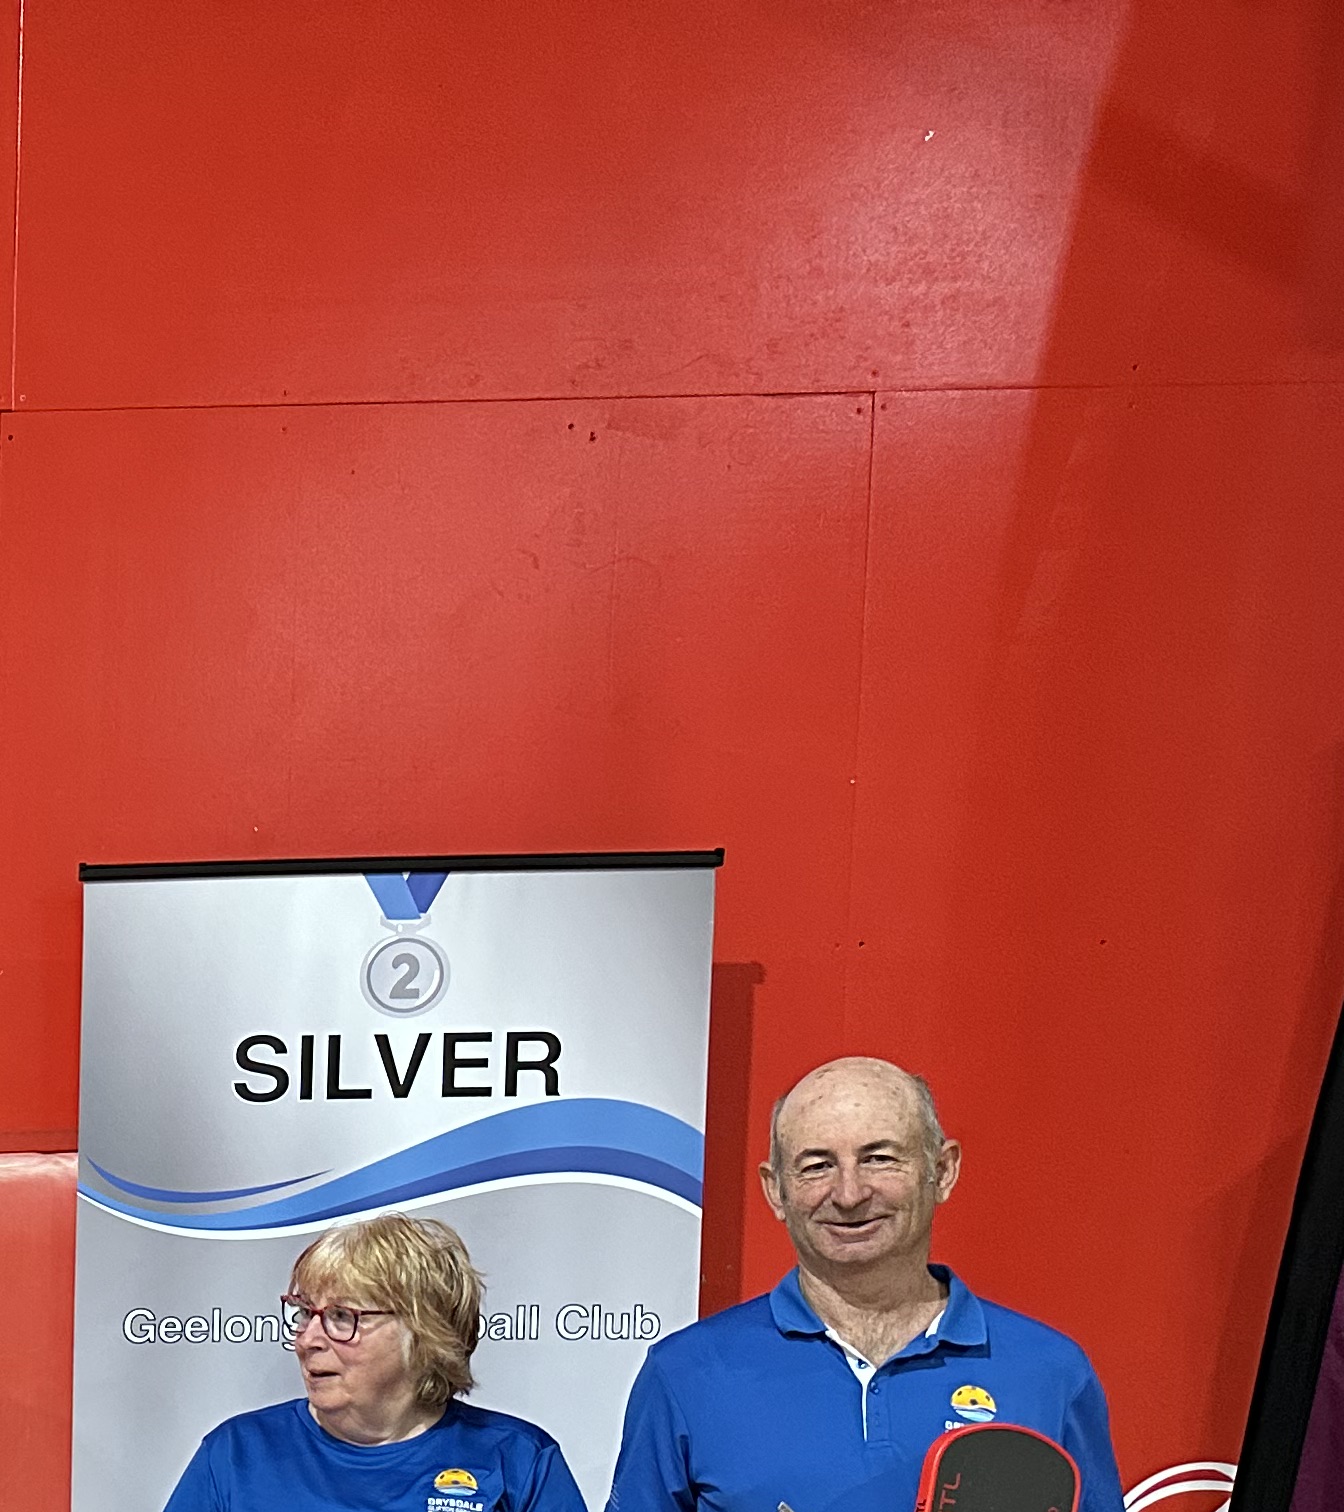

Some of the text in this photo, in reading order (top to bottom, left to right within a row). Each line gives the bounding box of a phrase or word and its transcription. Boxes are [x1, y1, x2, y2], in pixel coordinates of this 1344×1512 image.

[389, 952, 420, 999] 2
[233, 1031, 563, 1103] SILVER
[556, 1303, 661, 1341] Club
[427, 1497, 484, 1512] DRYSDALE
